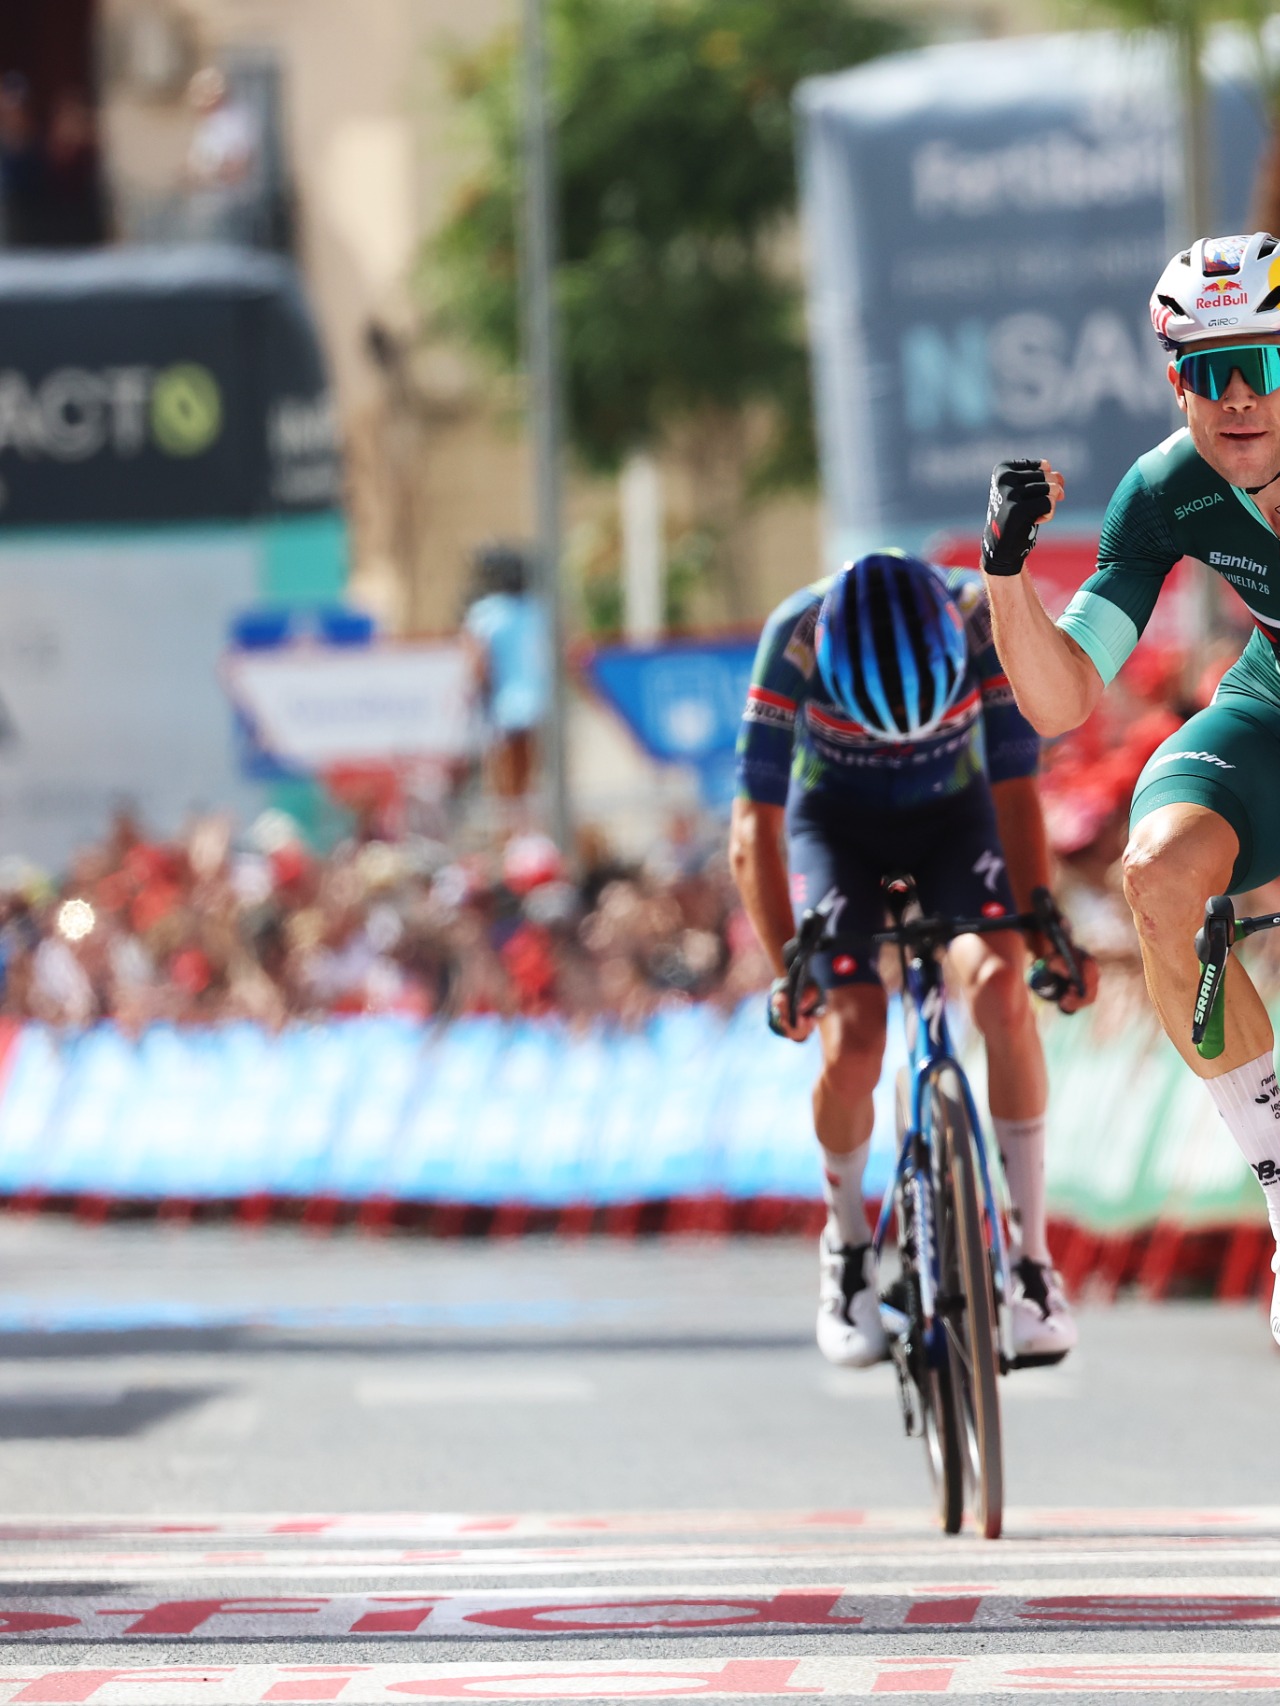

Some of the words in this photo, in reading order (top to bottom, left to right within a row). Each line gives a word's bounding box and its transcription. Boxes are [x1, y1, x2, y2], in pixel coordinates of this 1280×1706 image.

[1196, 296, 1221, 310] Red
[1224, 293, 1248, 307] Bull
[1208, 317, 1239, 327] GIRO
[904, 312, 1163, 432] NSA
[1209, 551, 1268, 576] Santini
[1258, 582, 1270, 595] 26
[1194, 963, 1217, 1025] SRAM
